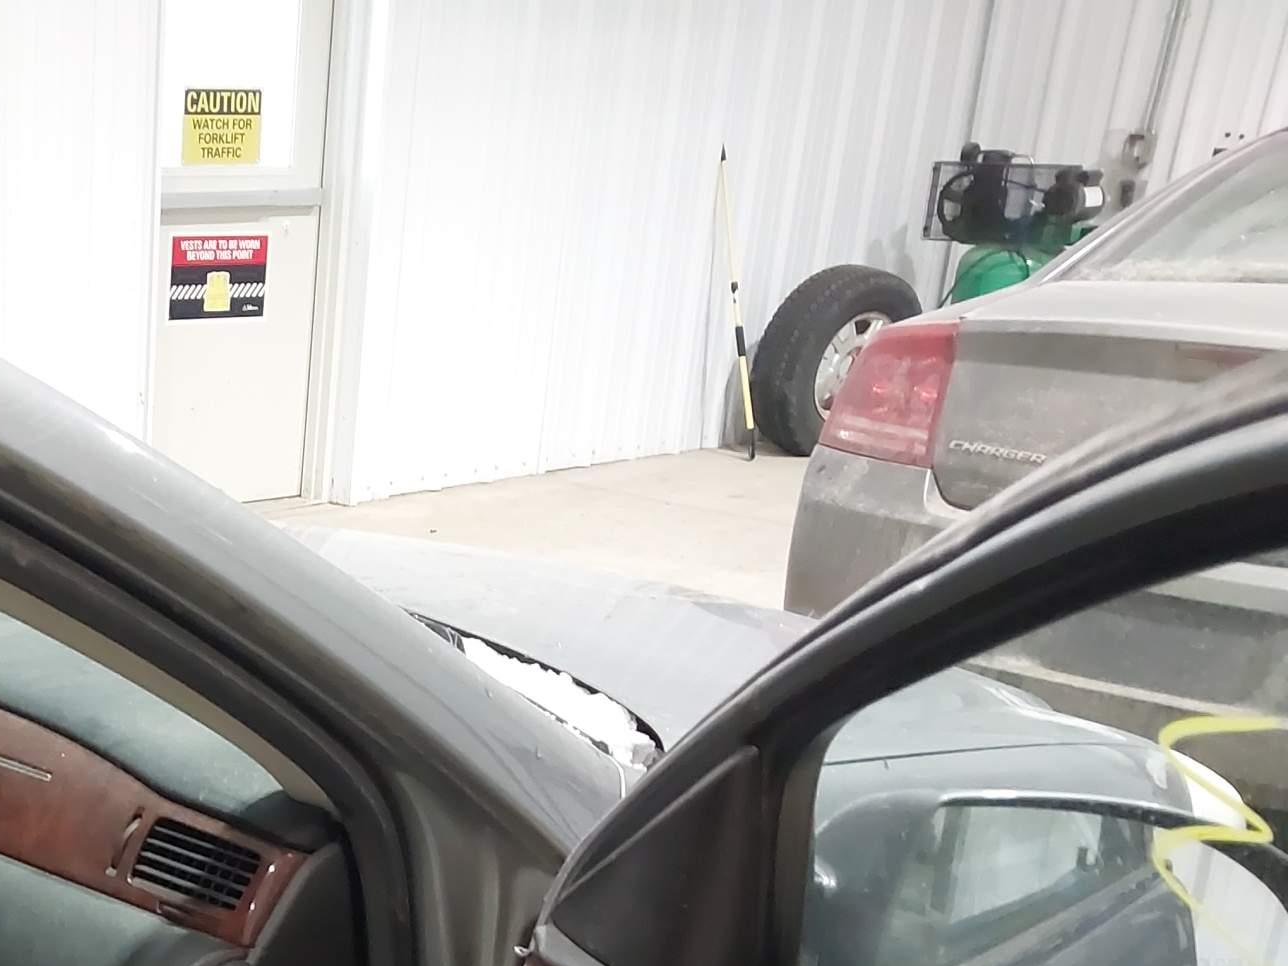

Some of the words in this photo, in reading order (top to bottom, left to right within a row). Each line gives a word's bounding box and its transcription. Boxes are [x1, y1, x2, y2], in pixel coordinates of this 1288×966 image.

[186, 91, 261, 113] CAUTION
[192, 118, 230, 131] WATCH
[232, 118, 252, 130] FOR
[198, 133, 245, 145] FORKLIFT
[201, 147, 242, 158] TRAFFIC
[180, 240, 203, 250] VESTS
[203, 240, 217, 250] ARE
[218, 240, 228, 249] TO
[228, 240, 237, 249] BE
[239, 239, 261, 249] WORN
[186, 250, 215, 261] BEYOND
[216, 250, 231, 260] THIS
[232, 249, 253, 260] POINT
[948, 439, 1048, 463] CHARGER
